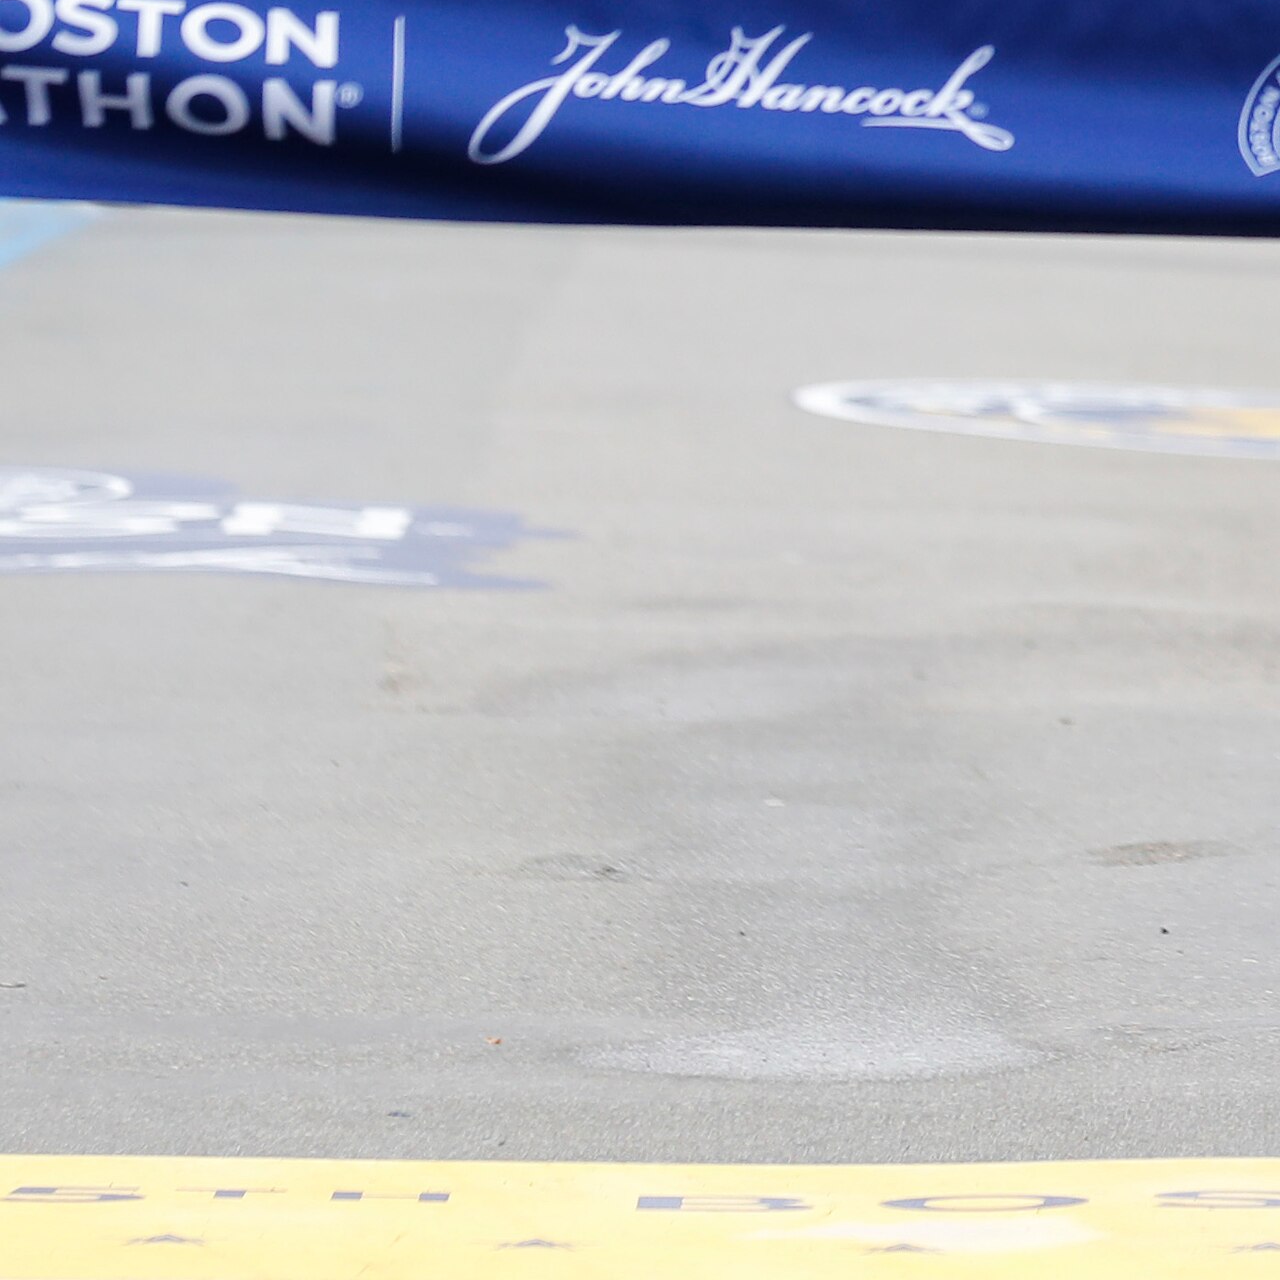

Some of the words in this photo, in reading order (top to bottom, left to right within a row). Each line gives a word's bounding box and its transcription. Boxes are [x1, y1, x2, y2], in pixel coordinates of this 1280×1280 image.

[0, 64, 338, 146] THON
[469, 24, 688, 165] John
[685, 24, 1016, 152] Hancock
